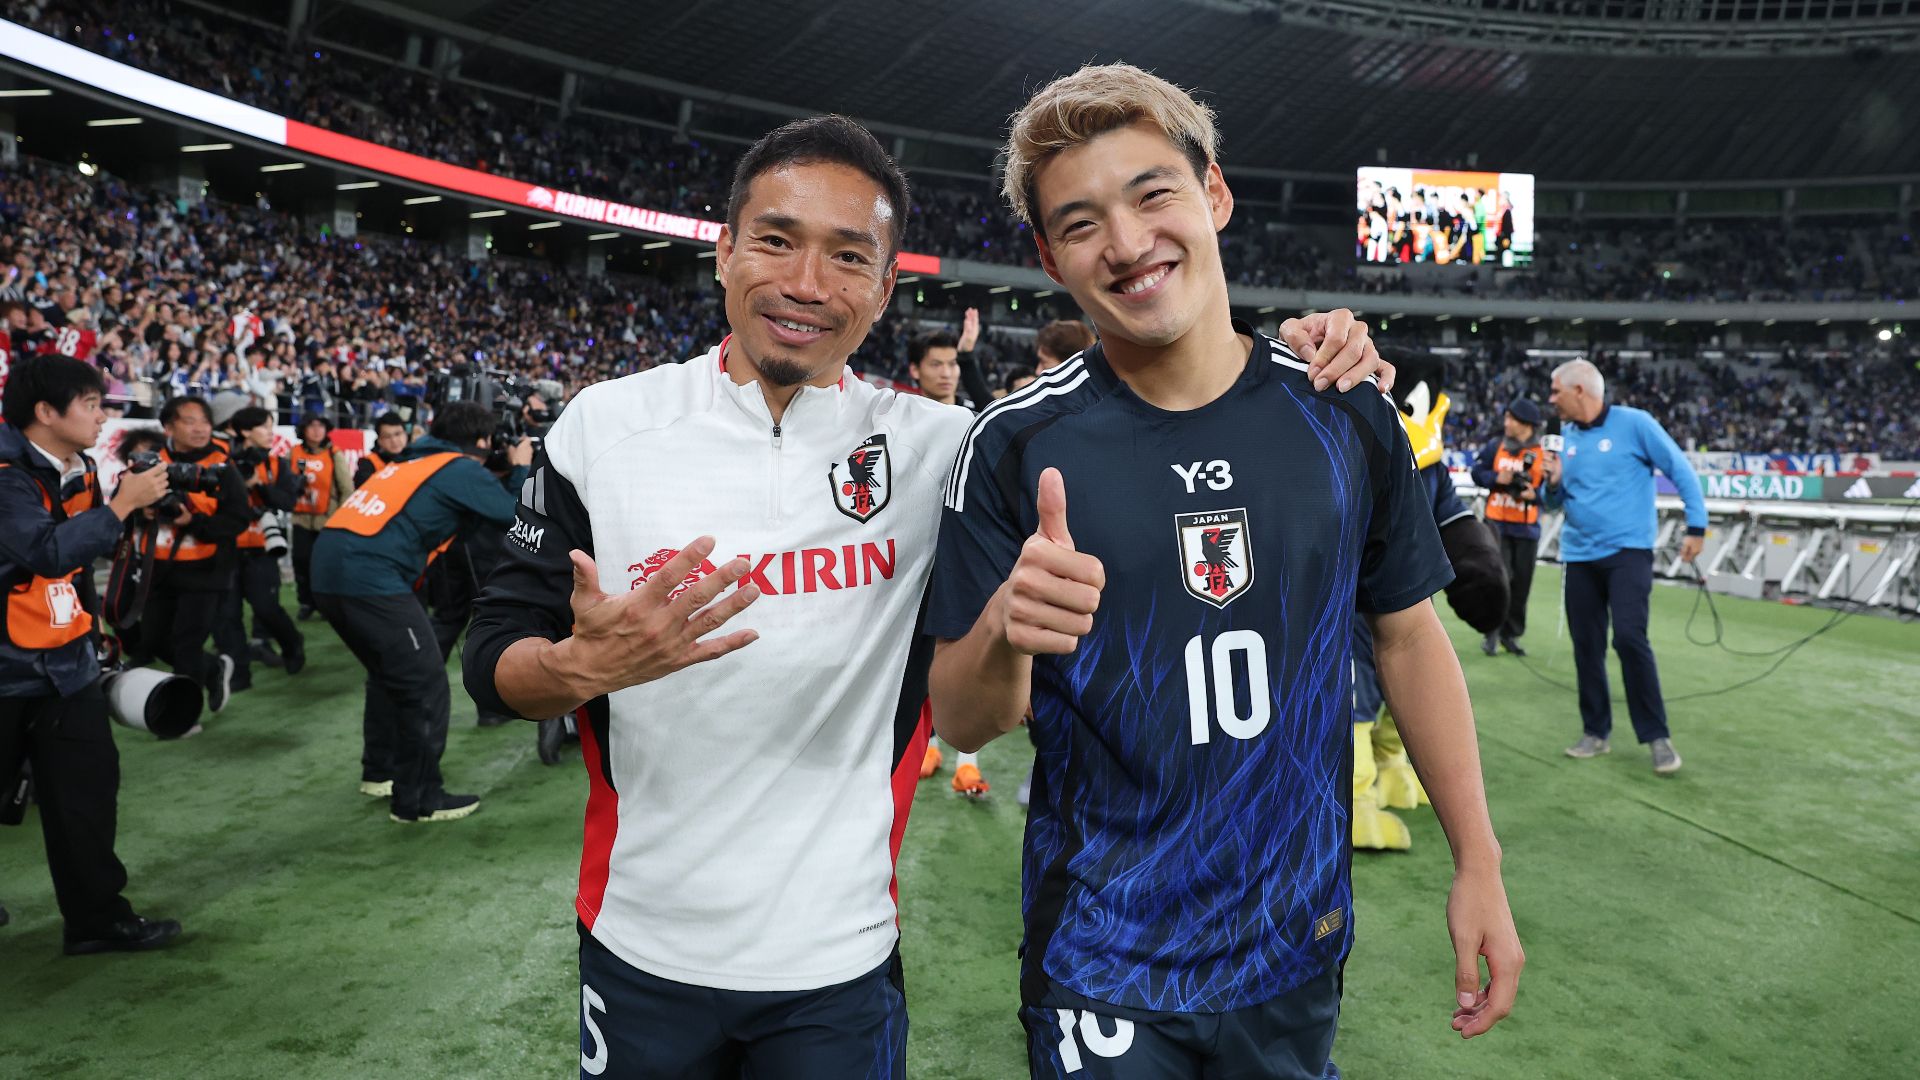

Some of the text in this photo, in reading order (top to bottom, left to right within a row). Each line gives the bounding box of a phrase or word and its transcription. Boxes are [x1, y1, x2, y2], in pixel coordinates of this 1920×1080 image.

[553, 190, 607, 222] KIRIN
[697, 221, 723, 243] CU
[1171, 459, 1234, 493] Y-3
[1707, 474, 1805, 499] MS&AD
[850, 493, 877, 510] JFA
[1192, 513, 1230, 525] JAPAN
[737, 539, 897, 596] KIRIN
[1203, 574, 1235, 592] JFA
[1184, 629, 1272, 746] 10
